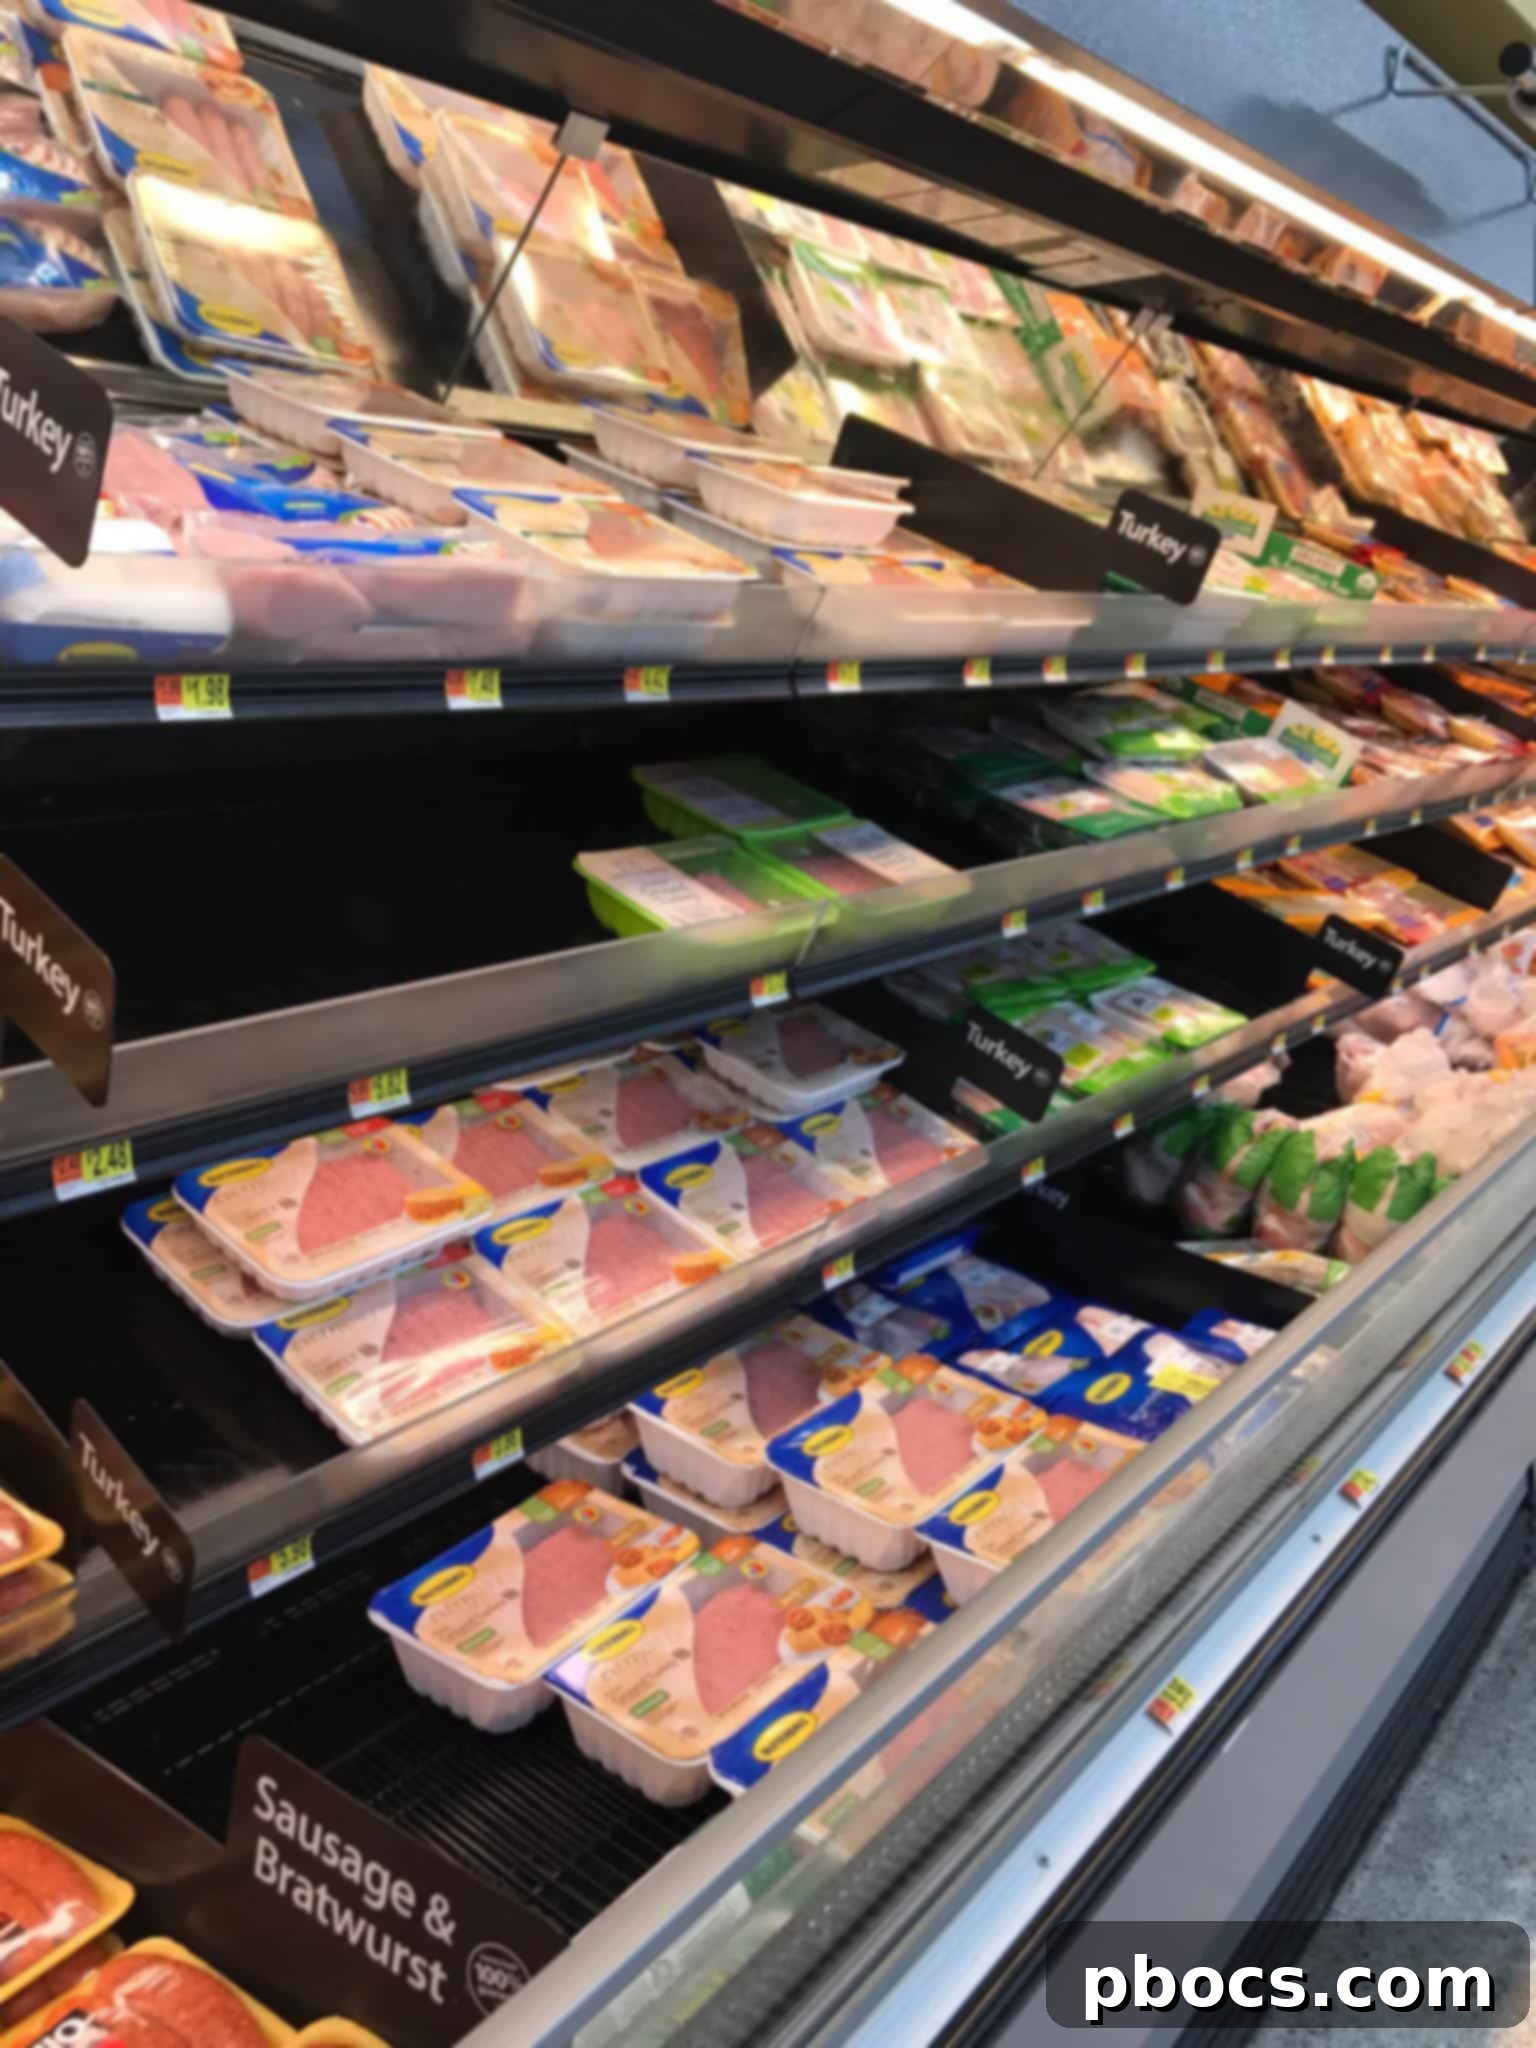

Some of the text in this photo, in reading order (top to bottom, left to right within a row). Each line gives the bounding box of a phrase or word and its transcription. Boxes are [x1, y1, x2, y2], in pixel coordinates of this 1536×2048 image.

[1118, 510, 1187, 564] Turkey
[0, 896, 81, 1016] Turkey
[1323, 926, 1378, 969] Turkey
[967, 1022, 1032, 1079] Turkey
[77, 1432, 160, 1557] Turkey
[254, 1774, 458, 1946] Sausage &
[254, 1836, 449, 2005] Bratwurst
